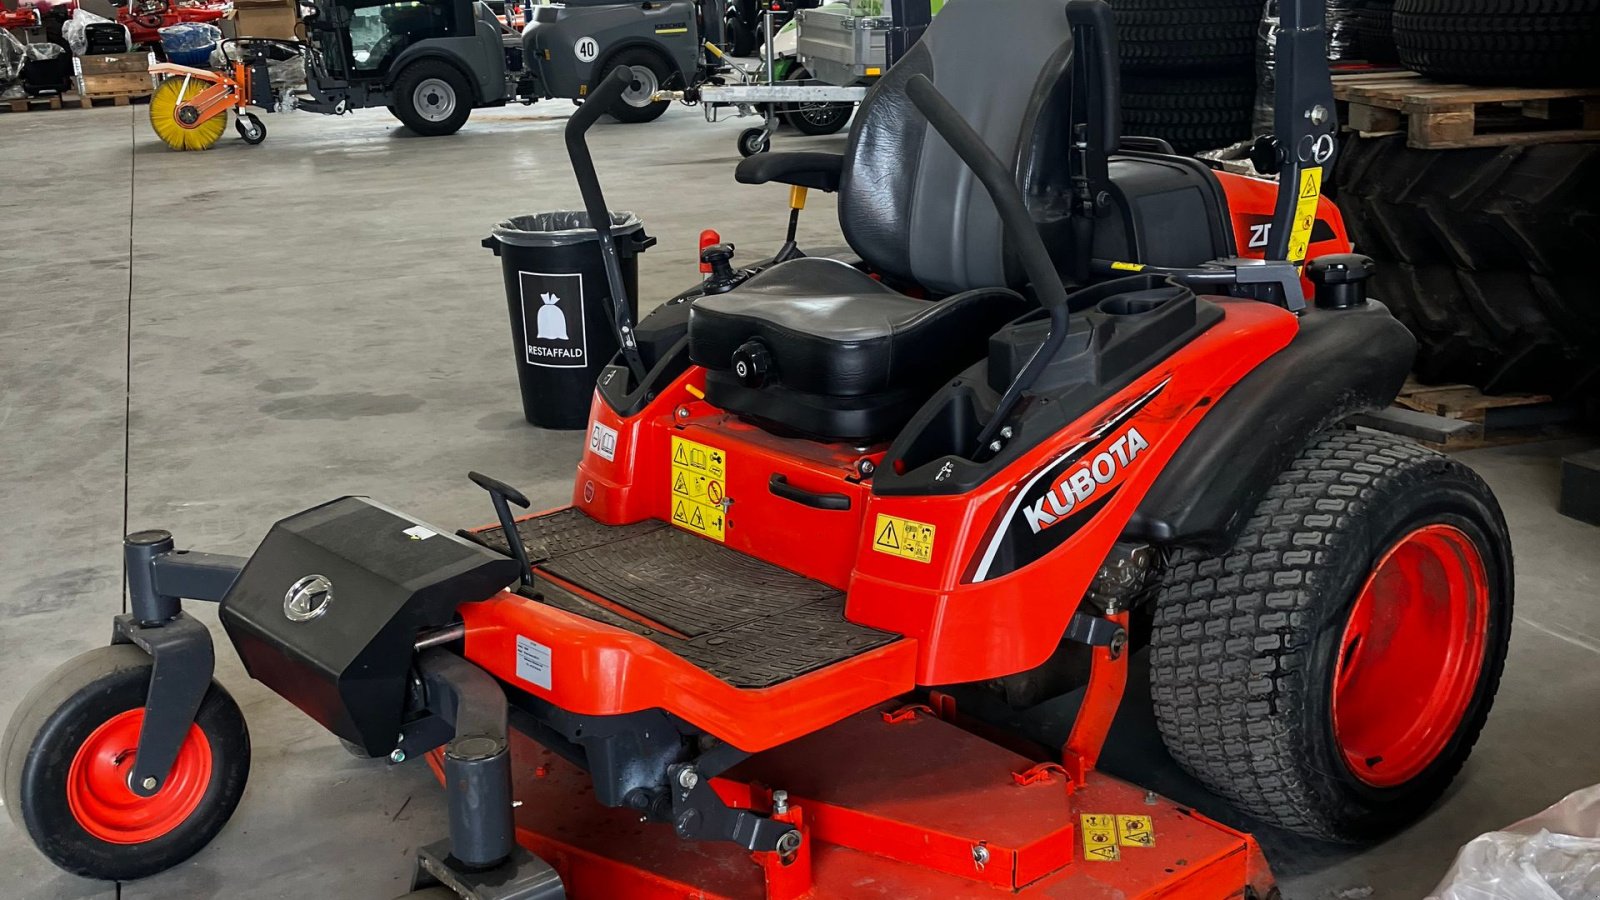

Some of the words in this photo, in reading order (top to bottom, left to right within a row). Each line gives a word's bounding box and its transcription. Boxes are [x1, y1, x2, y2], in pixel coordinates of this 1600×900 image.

[580, 41, 594, 57] 40
[528, 345, 583, 358] RESTAFFALD
[1022, 426, 1150, 535] KUBOTA
